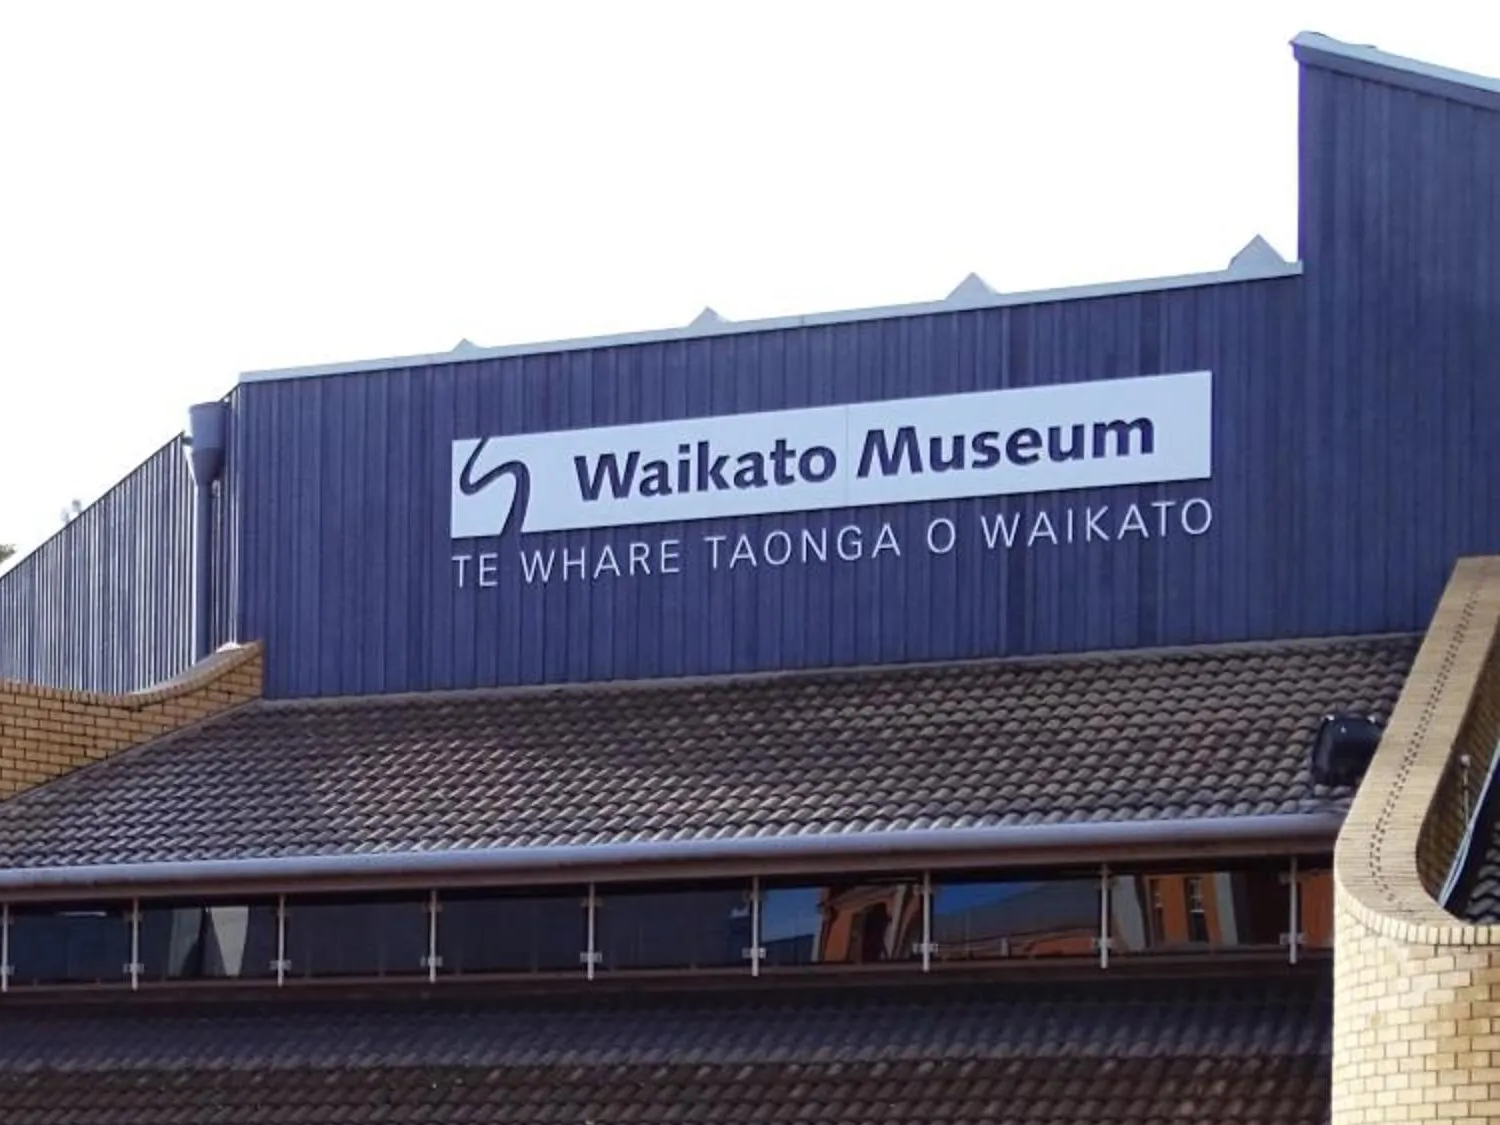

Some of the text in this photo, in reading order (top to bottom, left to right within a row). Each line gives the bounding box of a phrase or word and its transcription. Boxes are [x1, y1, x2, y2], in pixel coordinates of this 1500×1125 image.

[574, 415, 1155, 502] Waikato Museum
[452, 496, 1214, 588] TE WHARE TAONGA O WAIKATO
